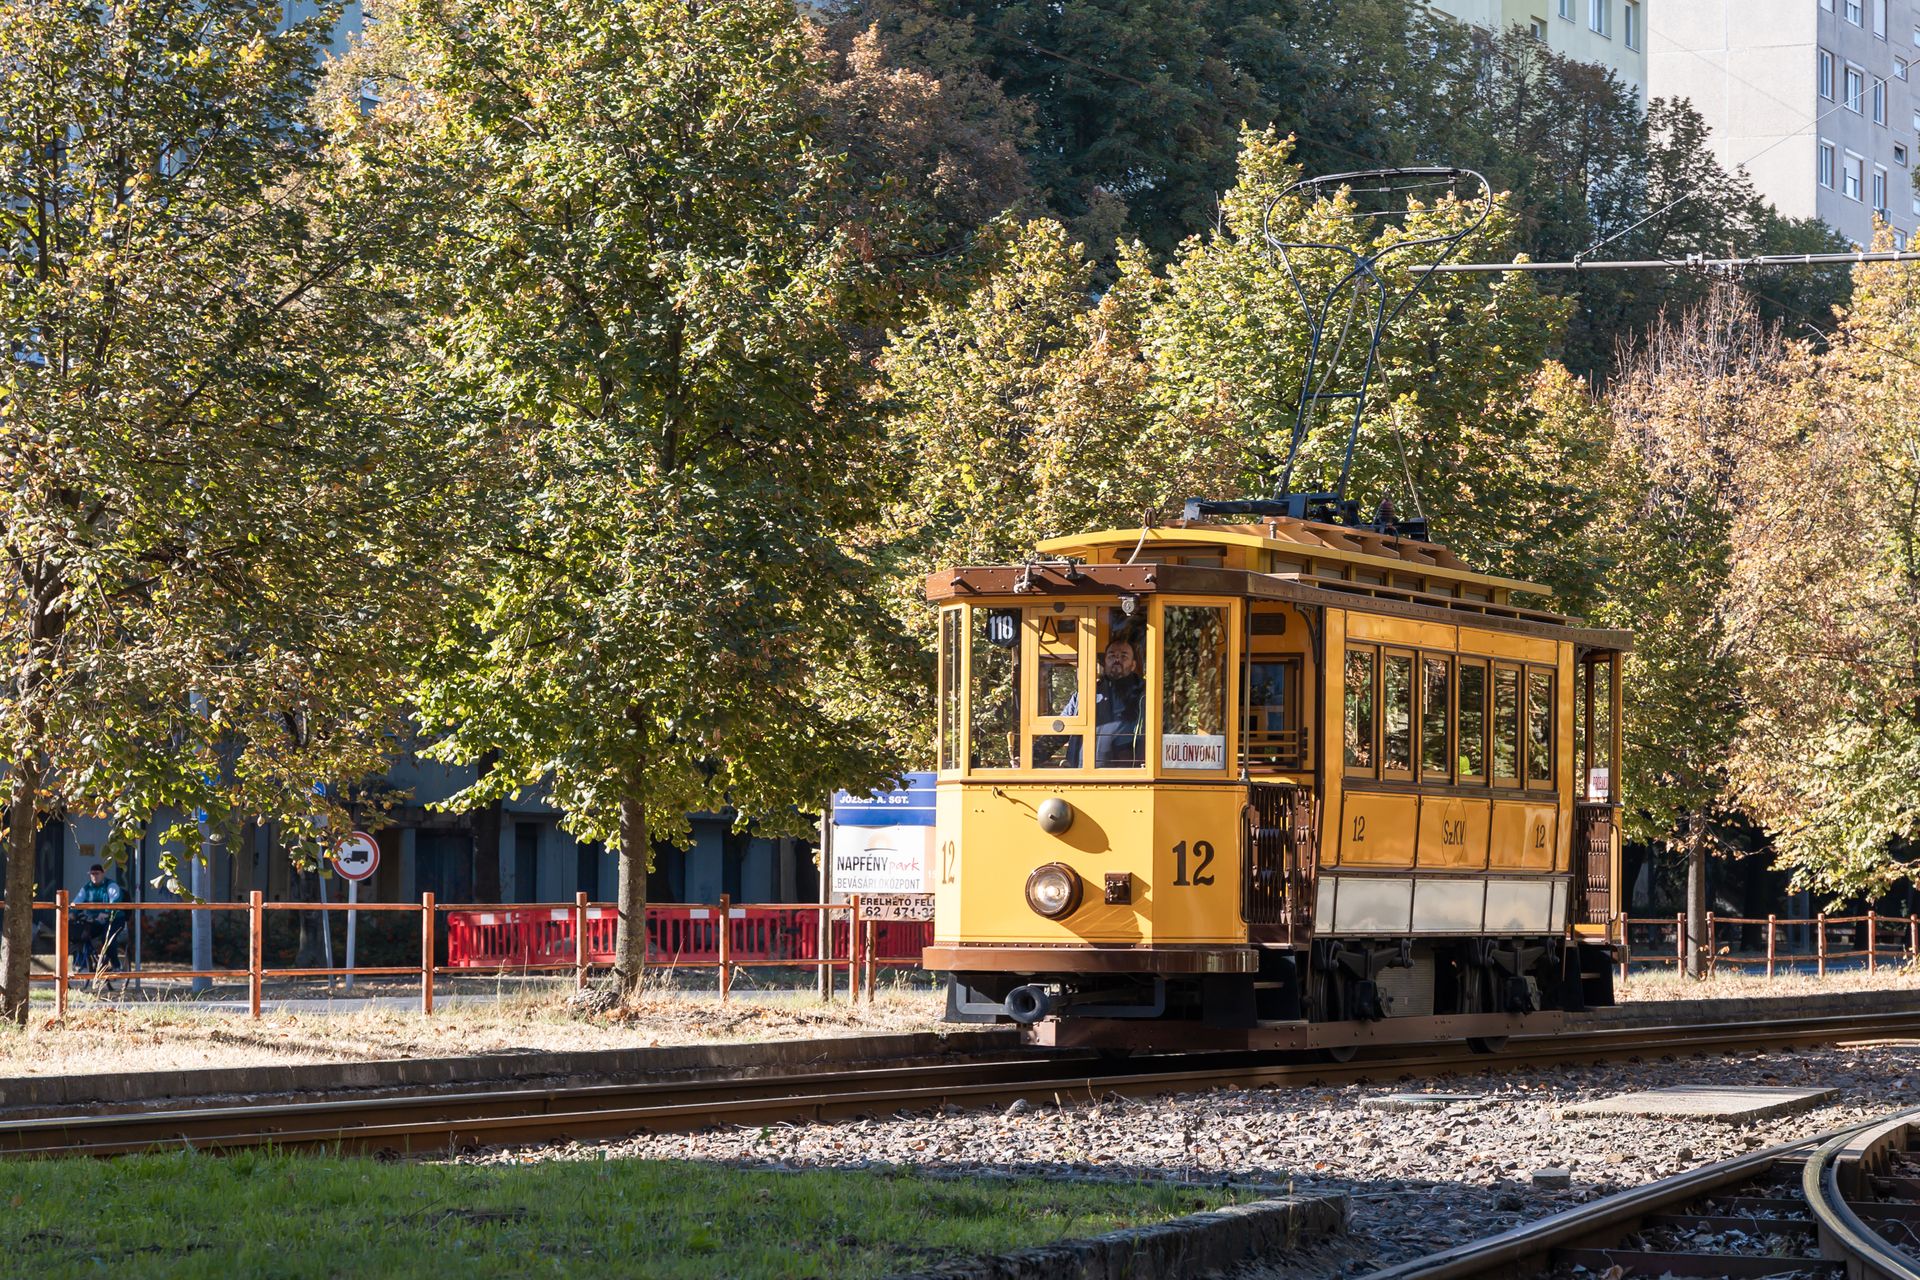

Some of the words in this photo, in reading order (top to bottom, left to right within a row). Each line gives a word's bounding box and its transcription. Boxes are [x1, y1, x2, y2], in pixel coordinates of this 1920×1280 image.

[1165, 742, 1222, 762] KÜLÖNVONAT
[877, 795, 886, 804] A.
[888, 795, 910, 804] SGT.
[1352, 815, 1366, 843] 12
[1443, 820, 1466, 847] SzKV
[1535, 824, 1546, 849] 12
[837, 853, 889, 871] NAPFÉNY
[889, 857, 920, 874] park
[942, 840, 955, 885] 12
[1172, 840, 1215, 886] 12
[866, 906, 881, 917] 62
